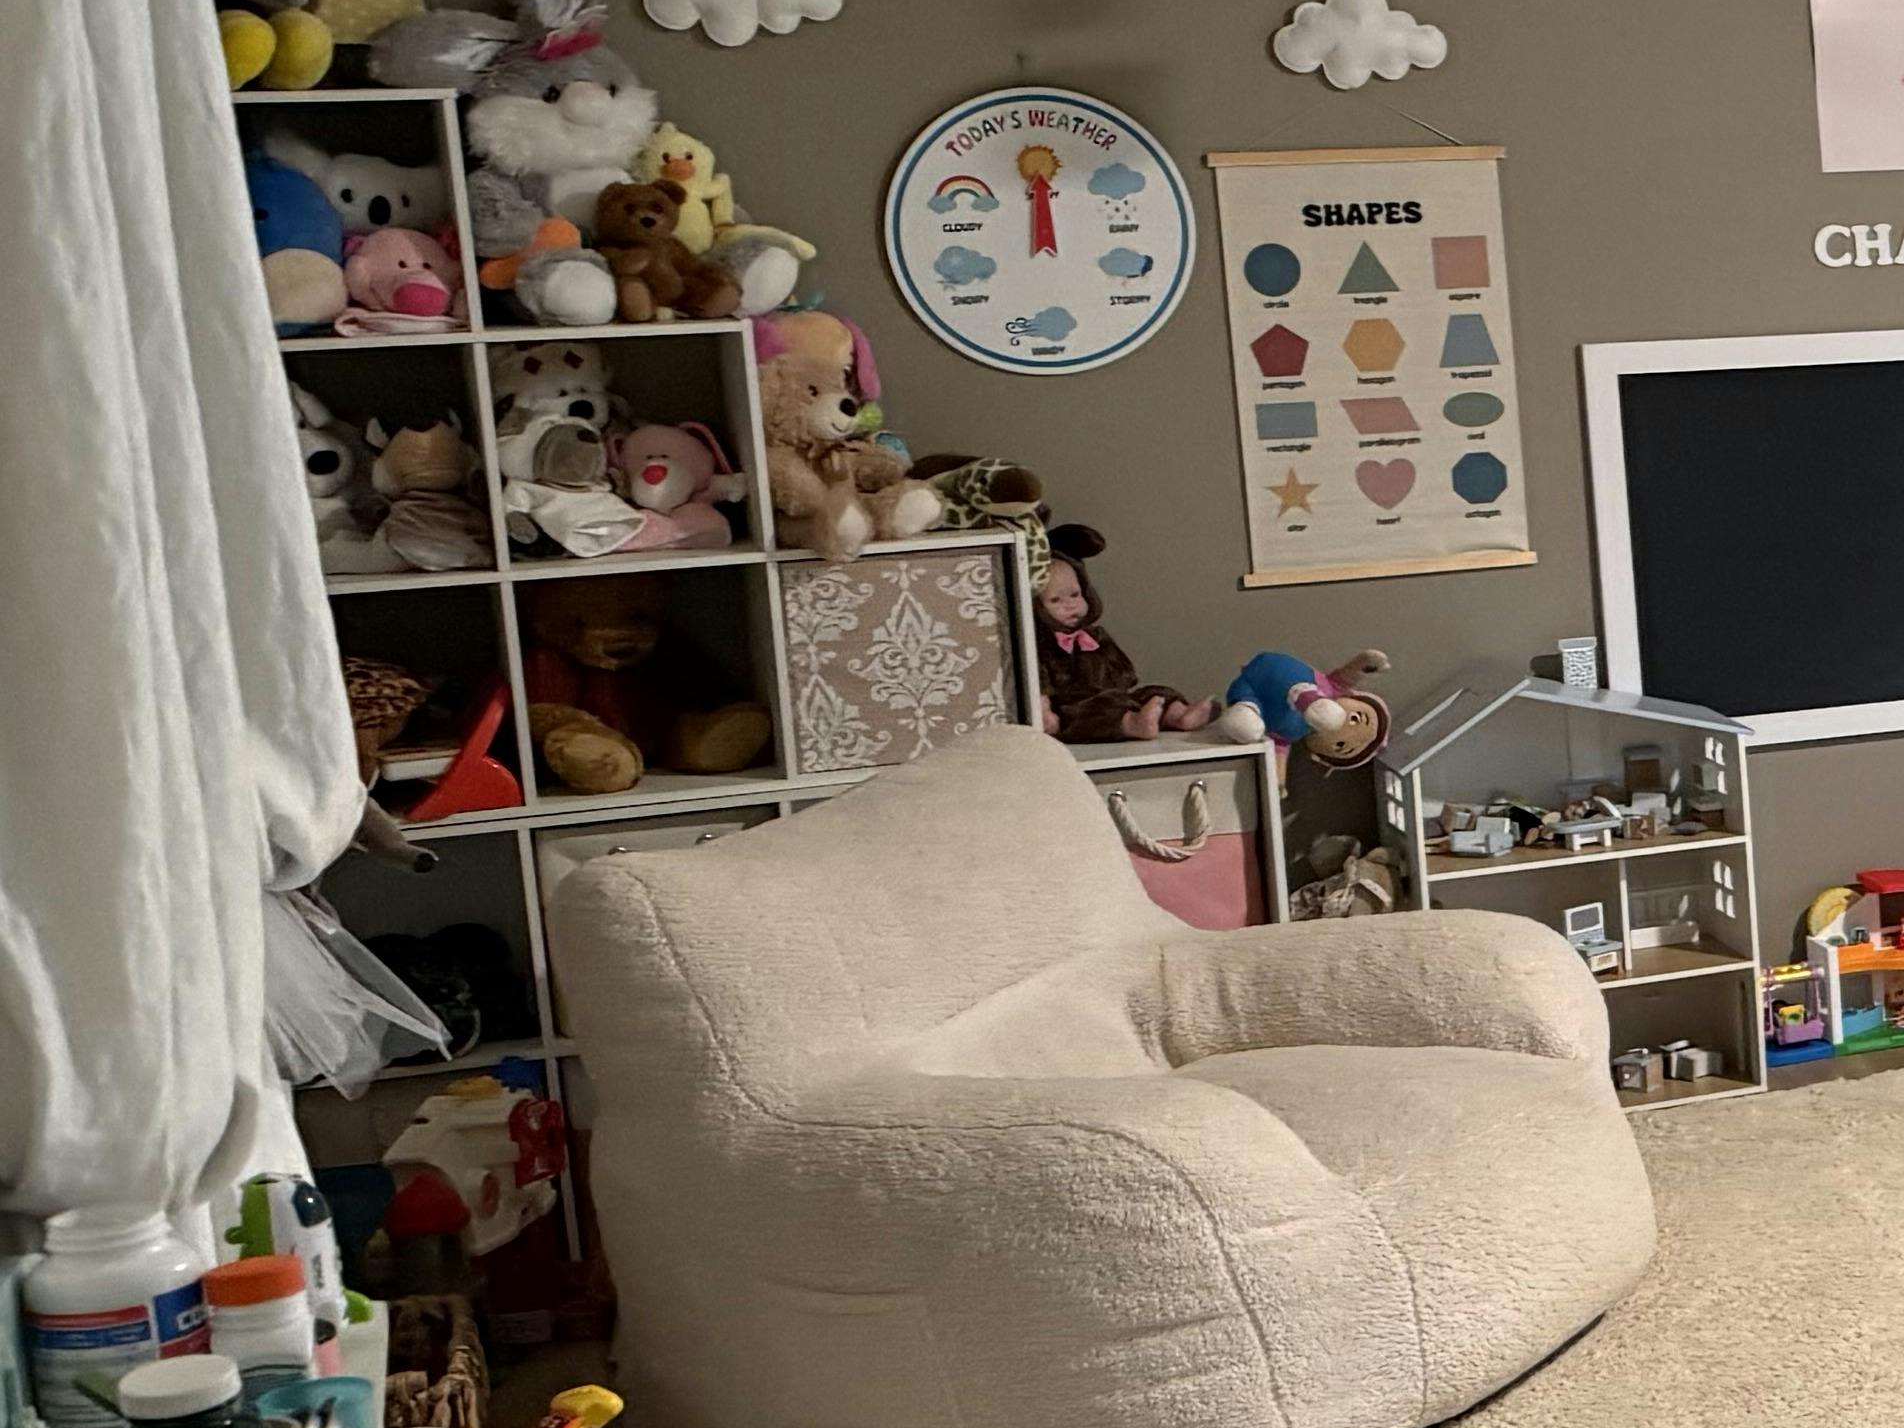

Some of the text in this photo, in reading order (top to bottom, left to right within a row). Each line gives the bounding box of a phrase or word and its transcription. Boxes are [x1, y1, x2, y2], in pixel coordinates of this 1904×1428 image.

[944, 109, 1119, 157] TODAYS WEATHER
[1302, 201, 1423, 227] SHAPES
